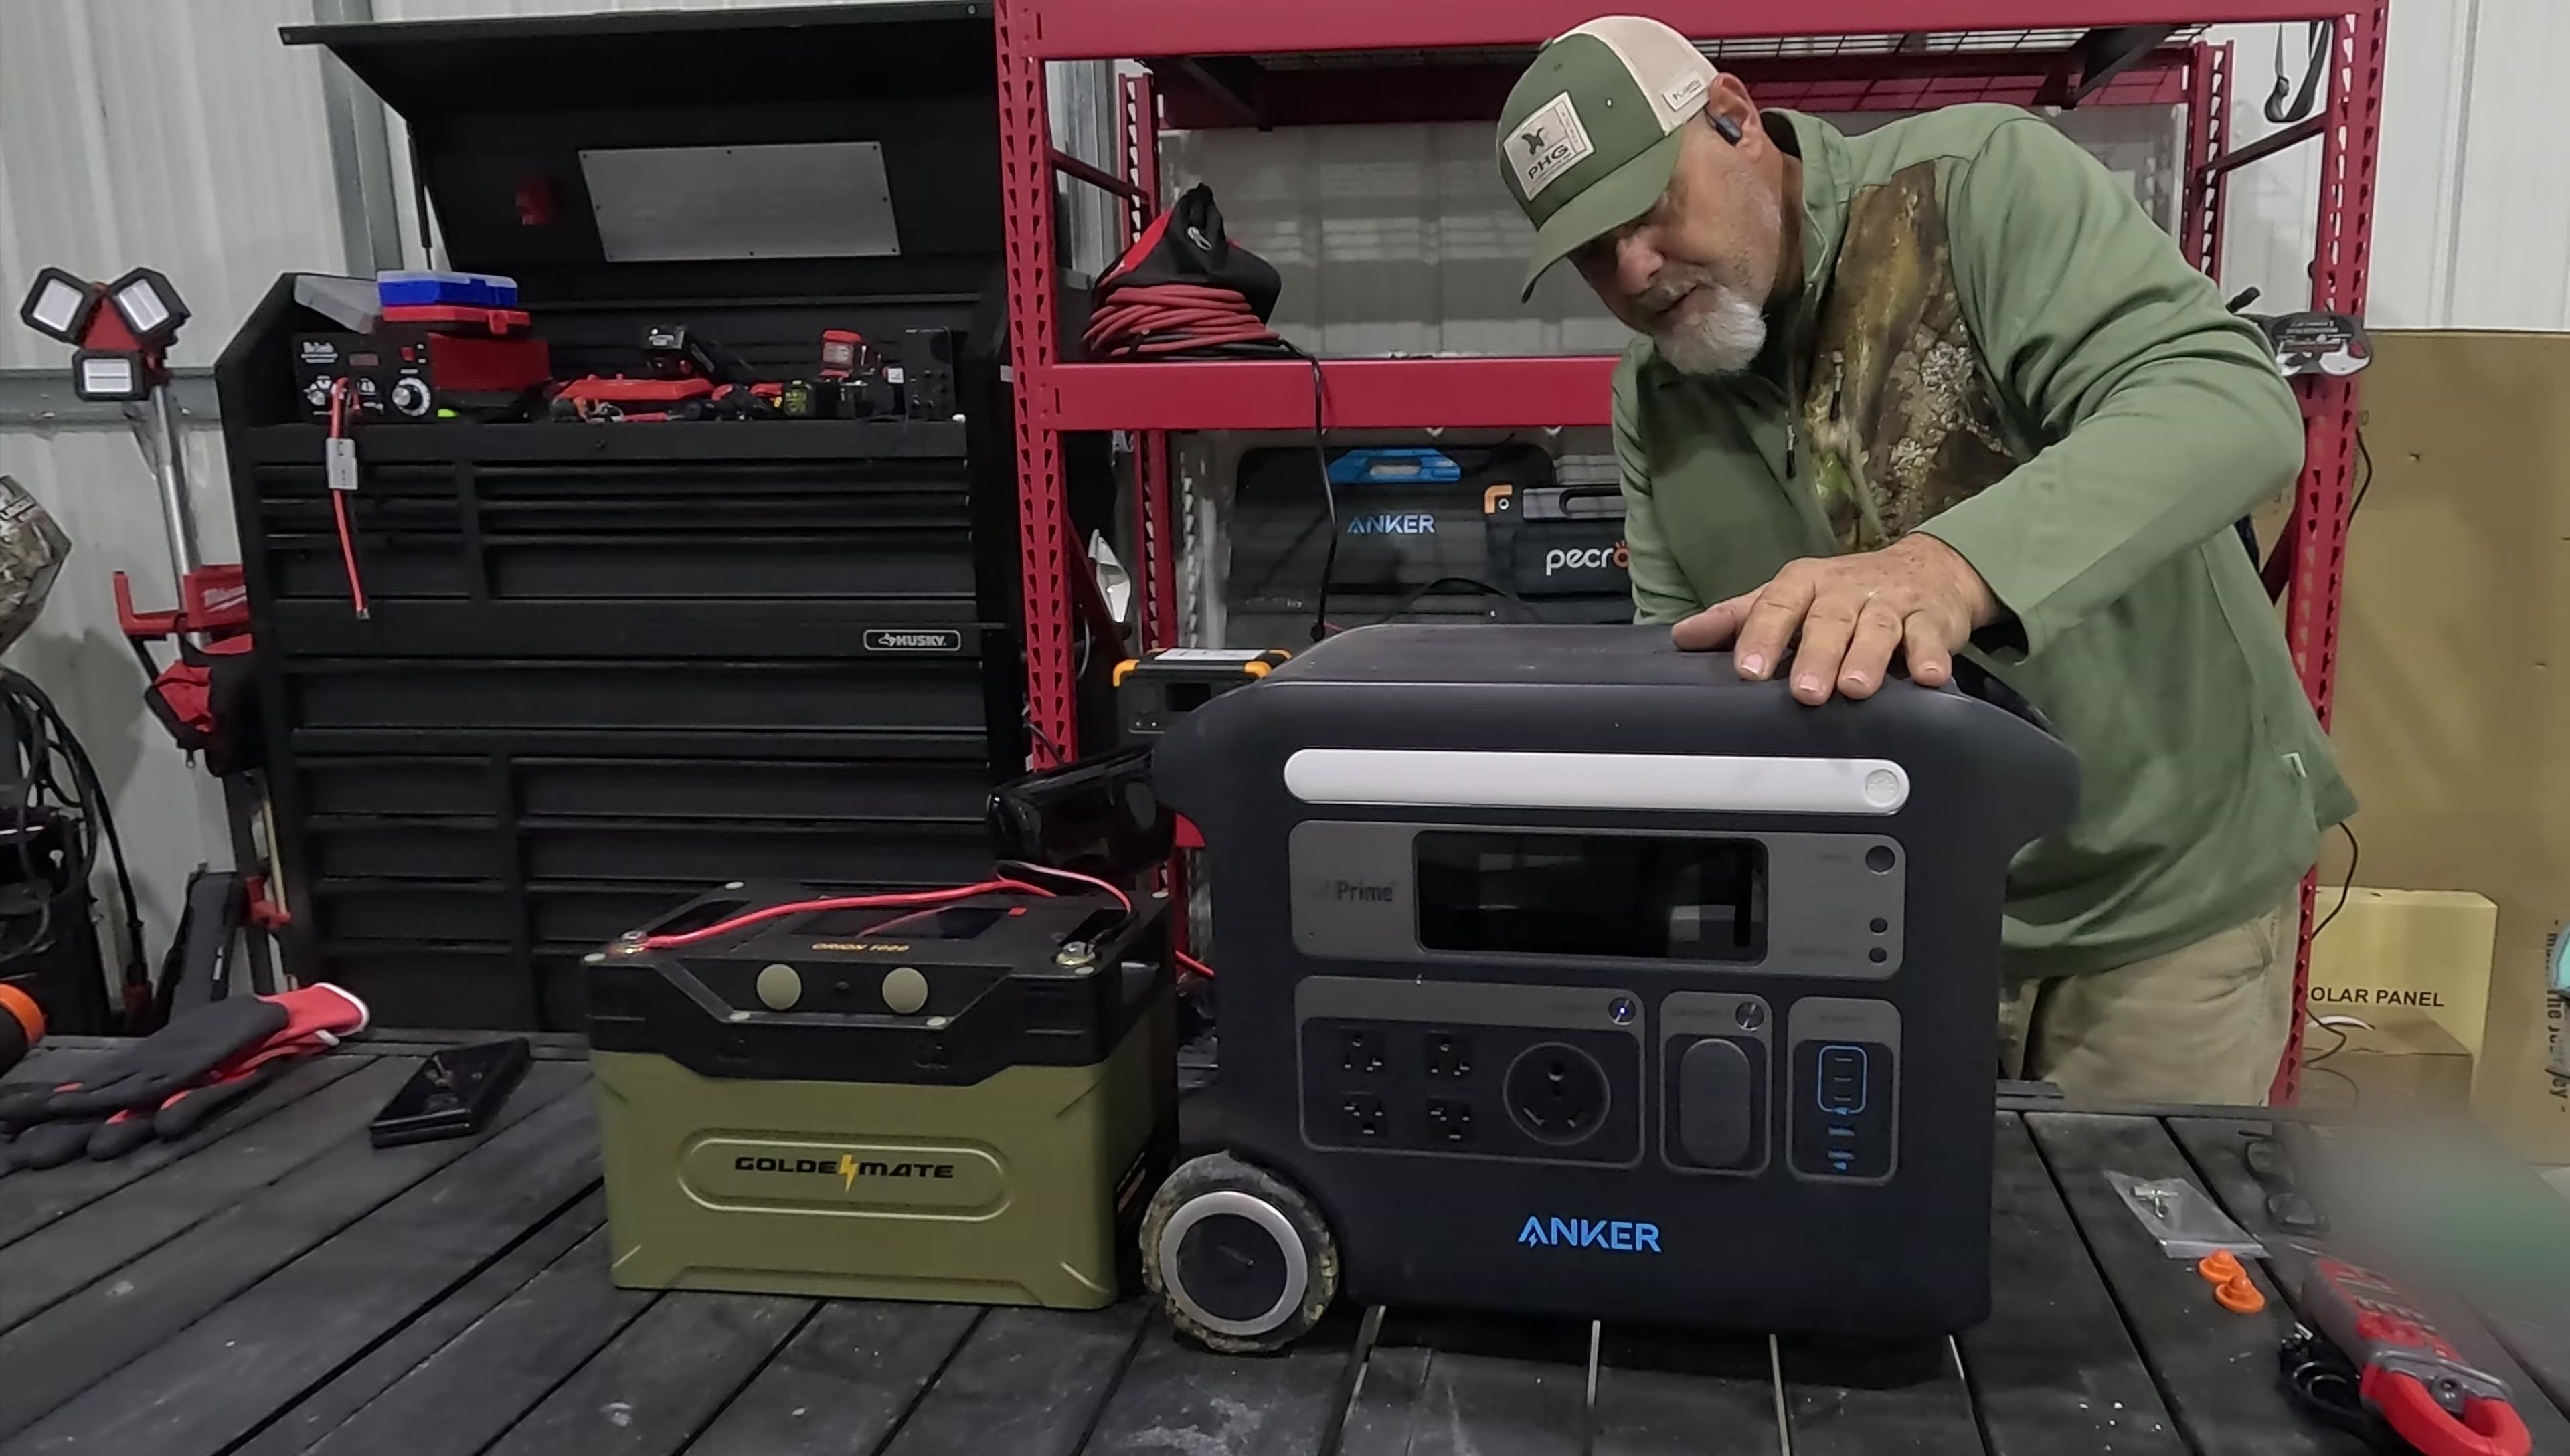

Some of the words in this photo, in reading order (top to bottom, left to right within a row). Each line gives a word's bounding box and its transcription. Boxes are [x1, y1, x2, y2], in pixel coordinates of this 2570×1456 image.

[1528, 144, 1569, 179] PHG
[1347, 514, 1436, 533] ANKER
[1546, 541, 1629, 576] pecro
[2310, 986, 2369, 1004] OLAR
[2376, 989, 2445, 1007] PANEL
[1517, 1216, 1662, 1253] ANKER
